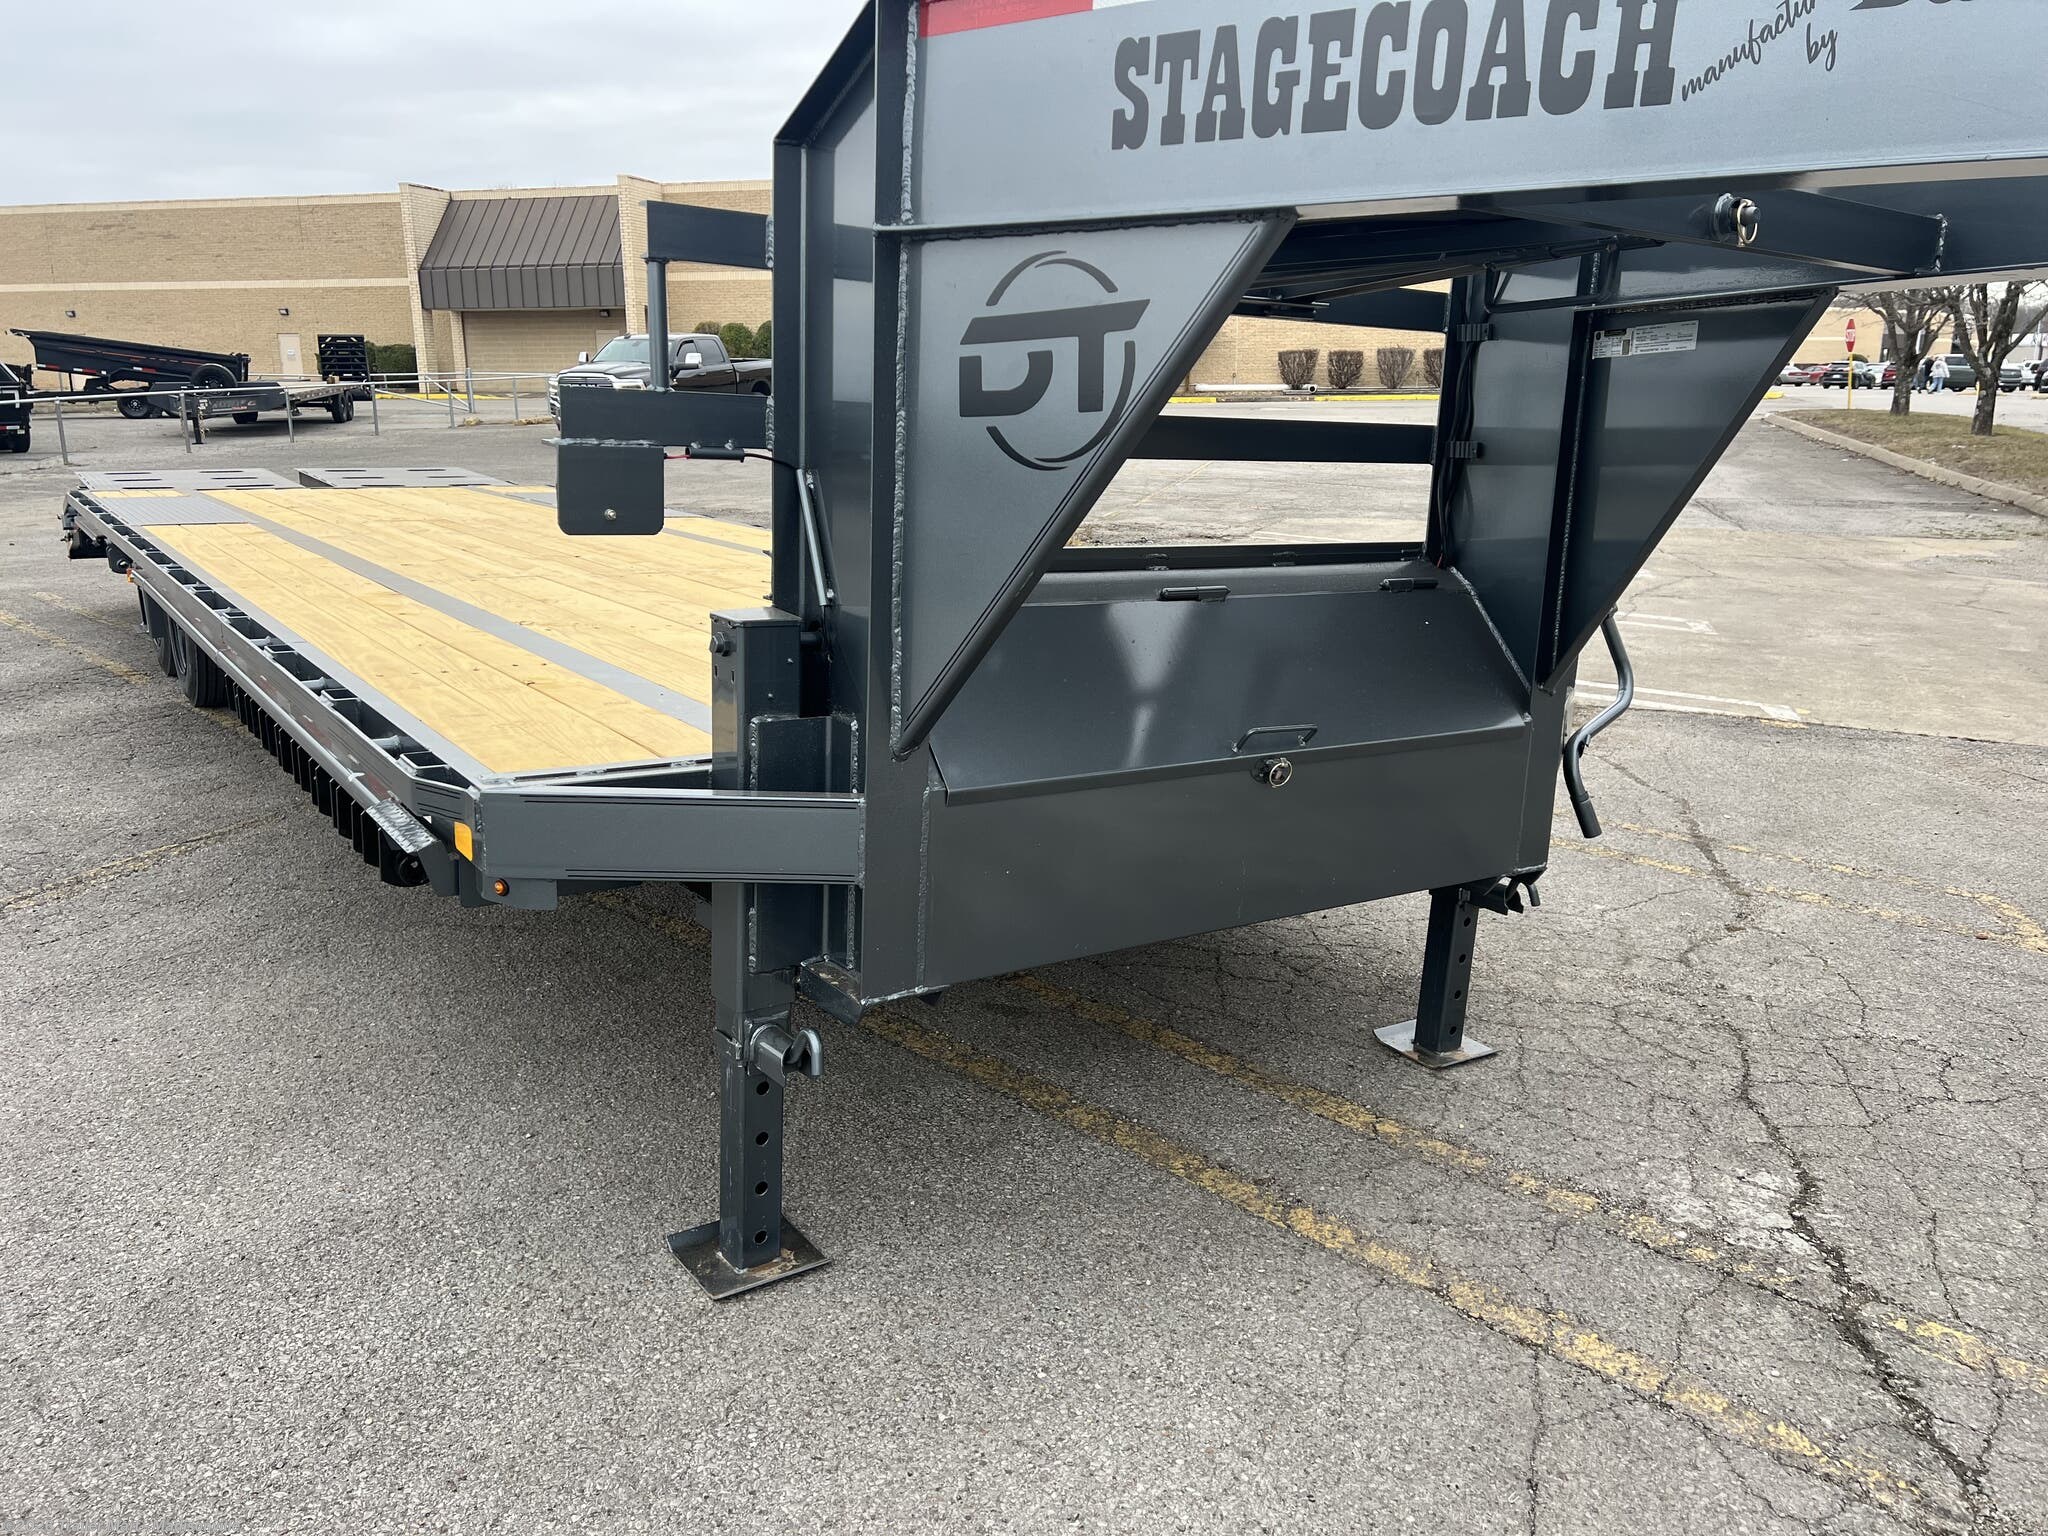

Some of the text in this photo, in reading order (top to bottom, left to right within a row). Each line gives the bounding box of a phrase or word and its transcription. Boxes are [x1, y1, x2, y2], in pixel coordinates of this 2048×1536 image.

[1111, 0, 1679, 150] STAGECOACH
[1681, 0, 1815, 101] manufactu
[1806, 22, 1838, 72] by
[959, 298, 1151, 418] DT
